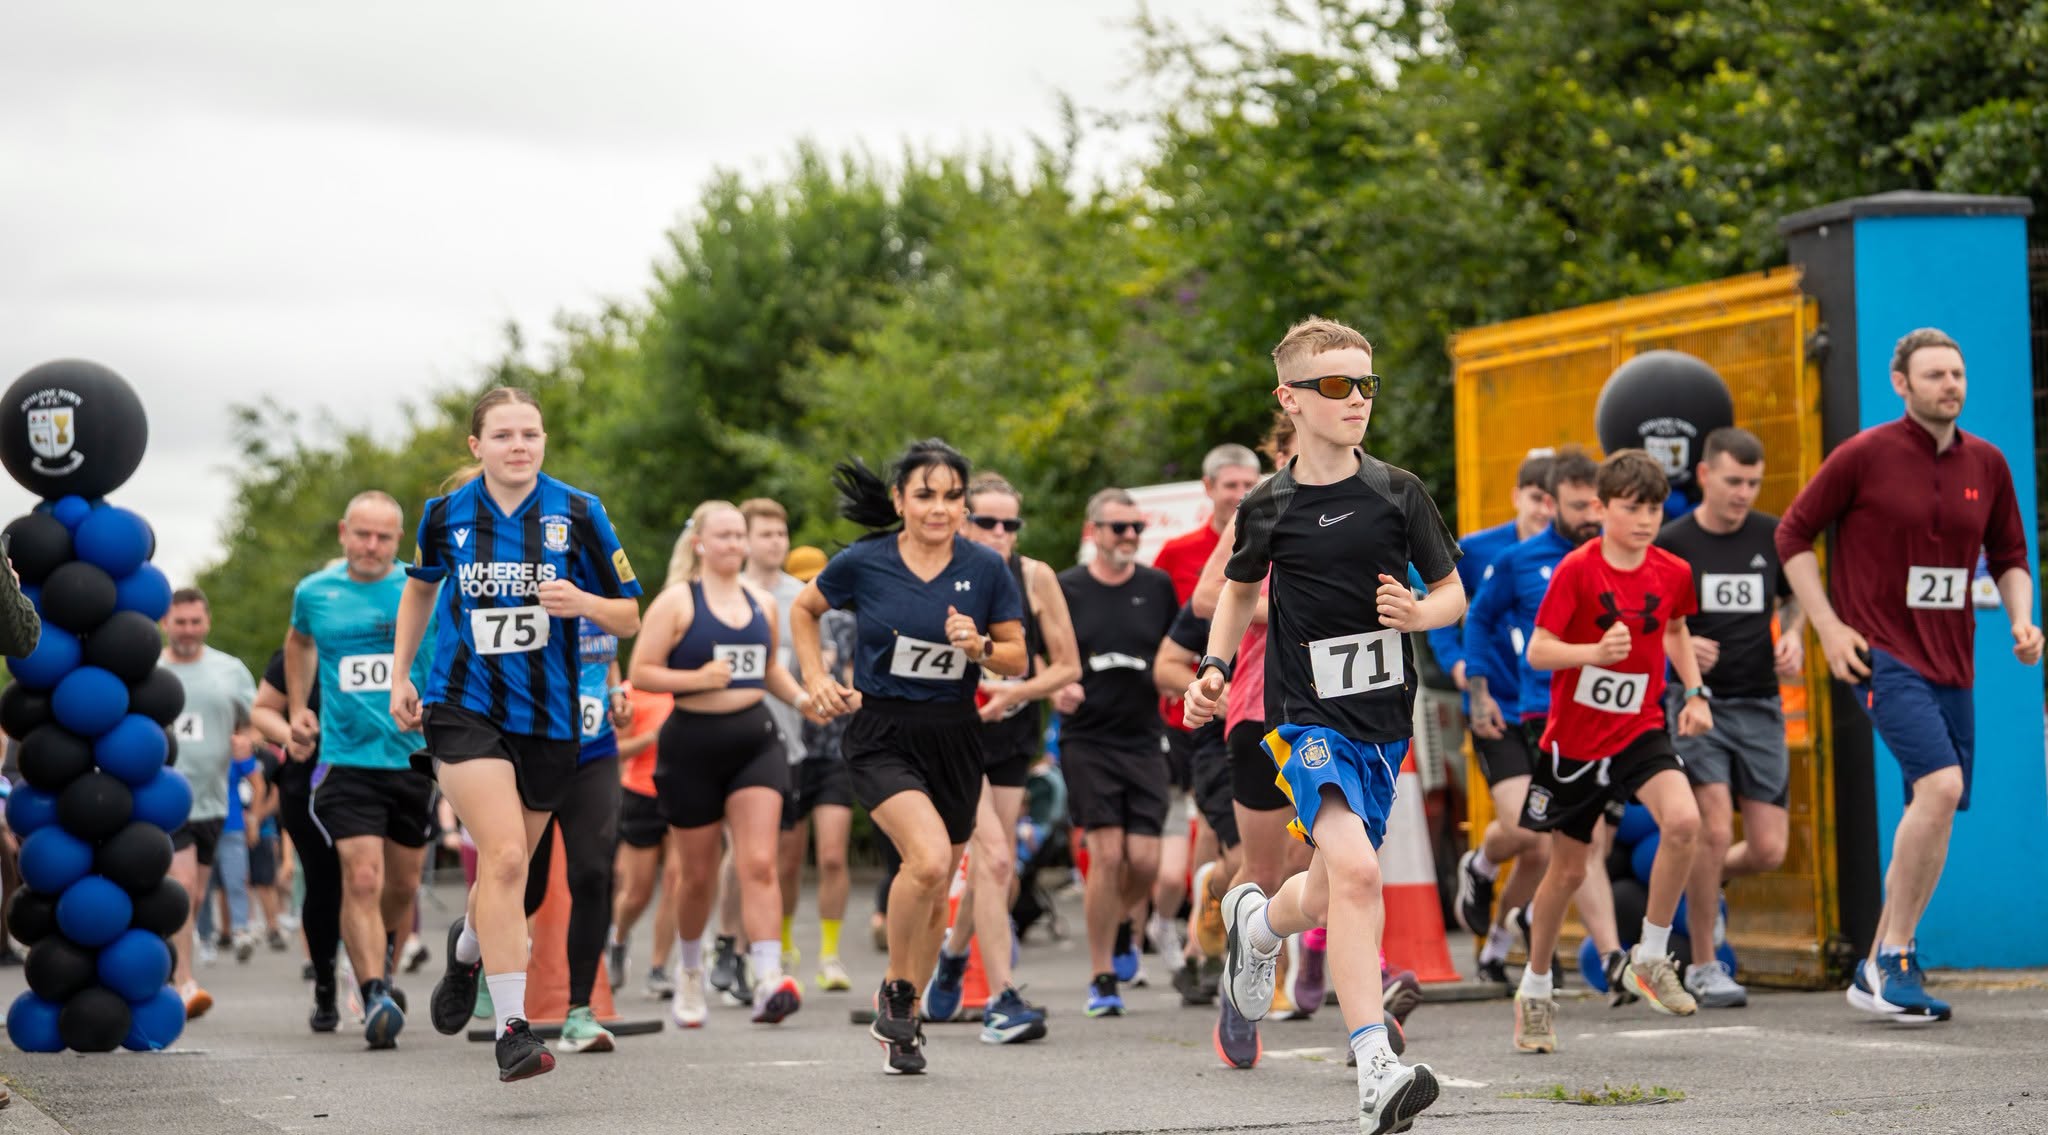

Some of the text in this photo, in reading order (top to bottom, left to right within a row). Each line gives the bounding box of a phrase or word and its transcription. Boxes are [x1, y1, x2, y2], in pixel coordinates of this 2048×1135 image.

[459, 562, 557, 580] WHERE IS
[1717, 581, 1751, 605] 68
[1919, 574, 1953, 602] 21
[486, 613, 536, 648] 75
[351, 661, 387, 686] 50
[727, 651, 755, 673] 38
[910, 645, 954, 674] 74
[1329, 639, 1390, 689] 71
[1592, 676, 1635, 708] 60
